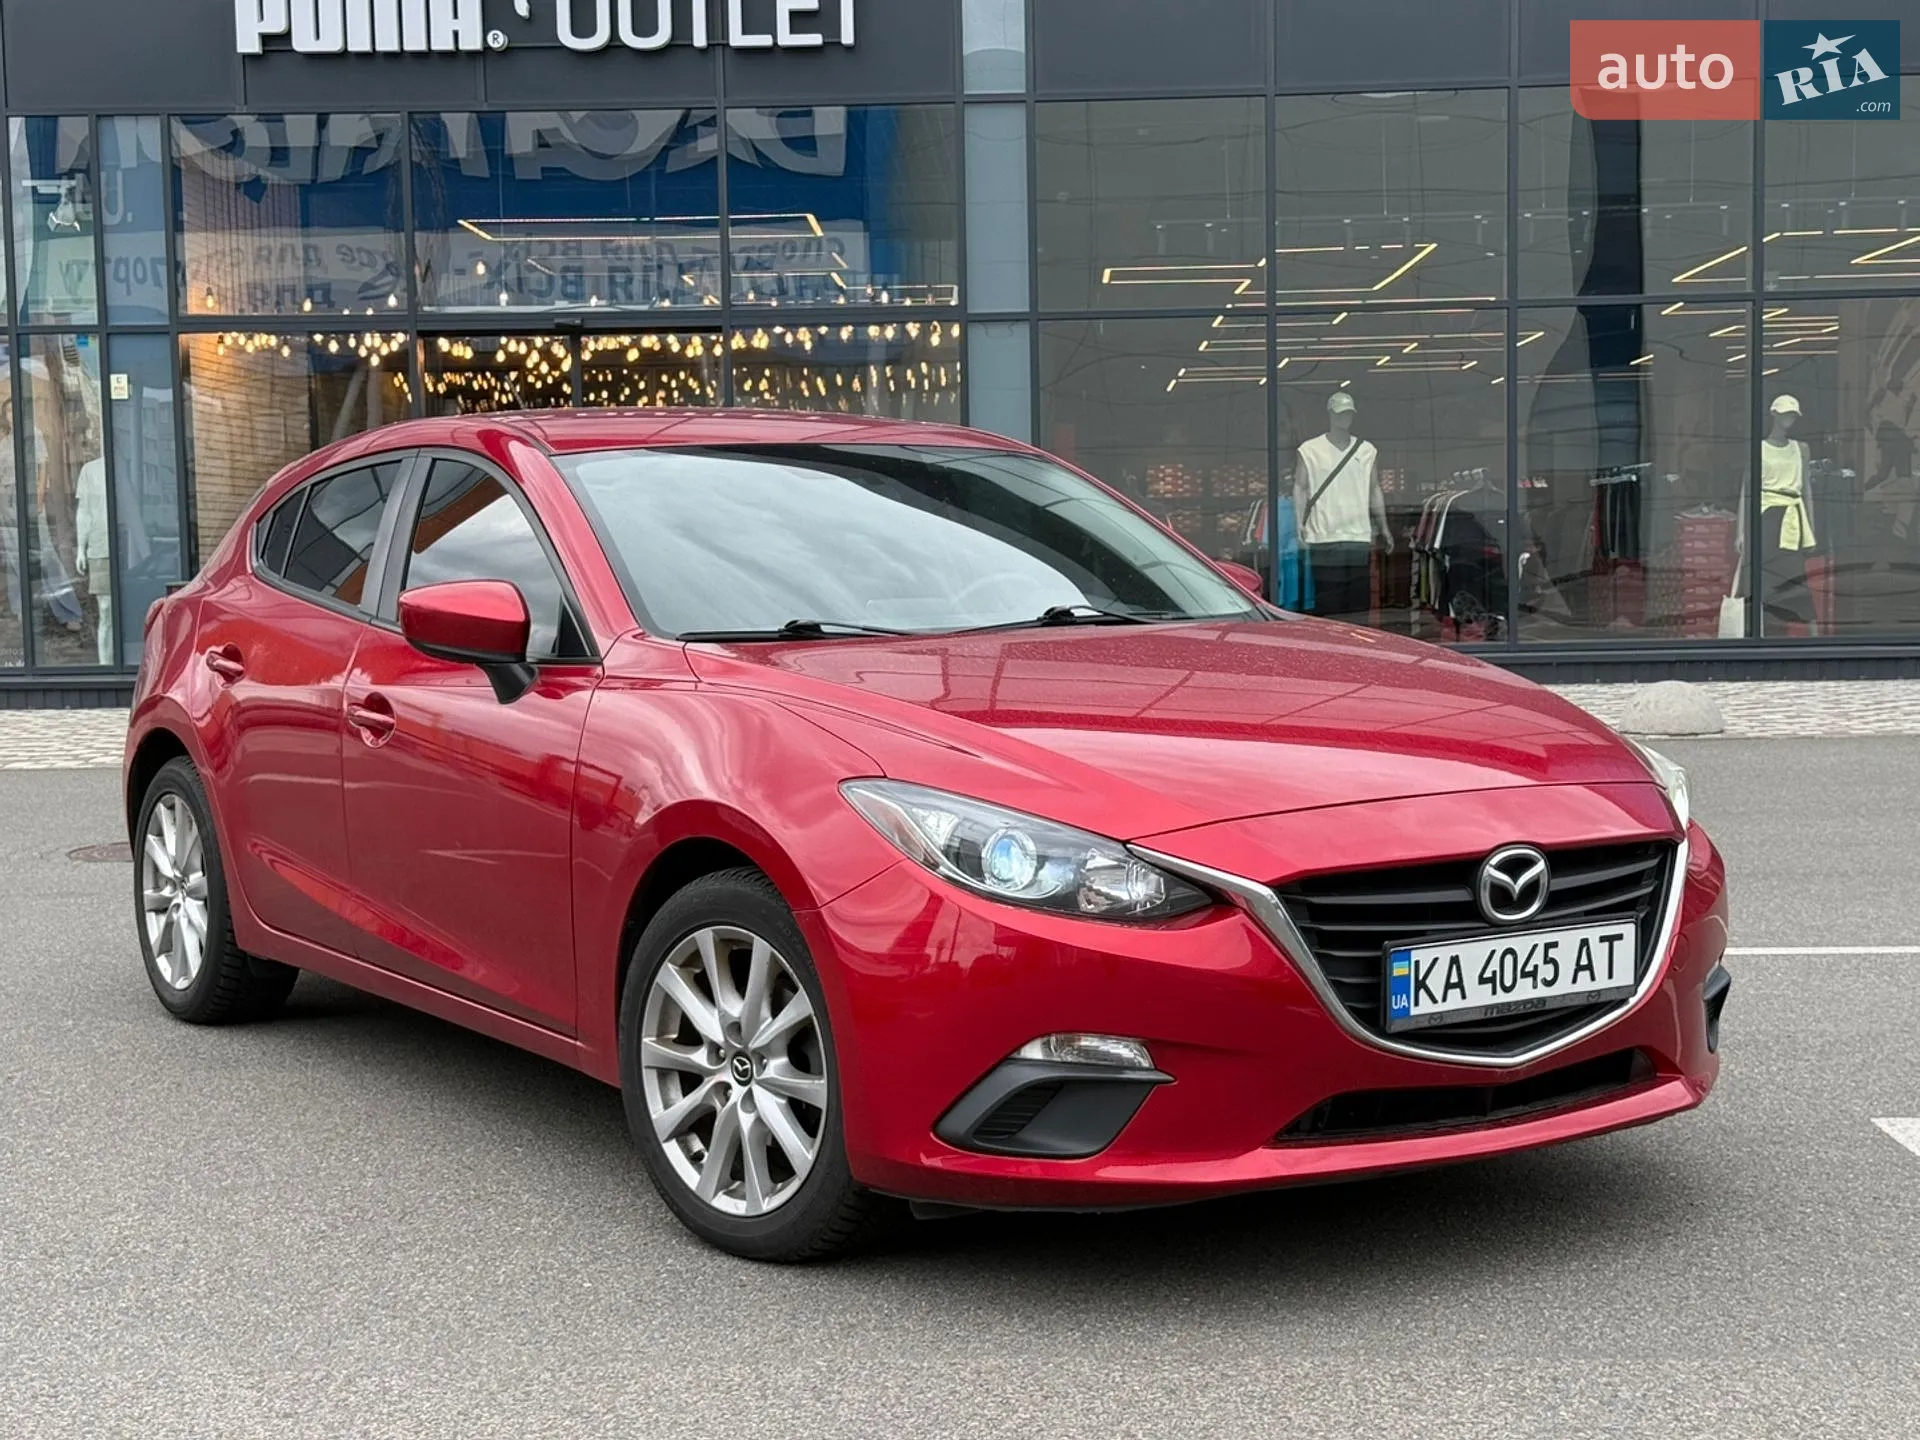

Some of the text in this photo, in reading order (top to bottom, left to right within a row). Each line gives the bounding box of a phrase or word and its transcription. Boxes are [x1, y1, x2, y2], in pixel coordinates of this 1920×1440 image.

[1414, 933, 1624, 1007] KA 4045 AT
[1392, 993, 1408, 1010] UA
